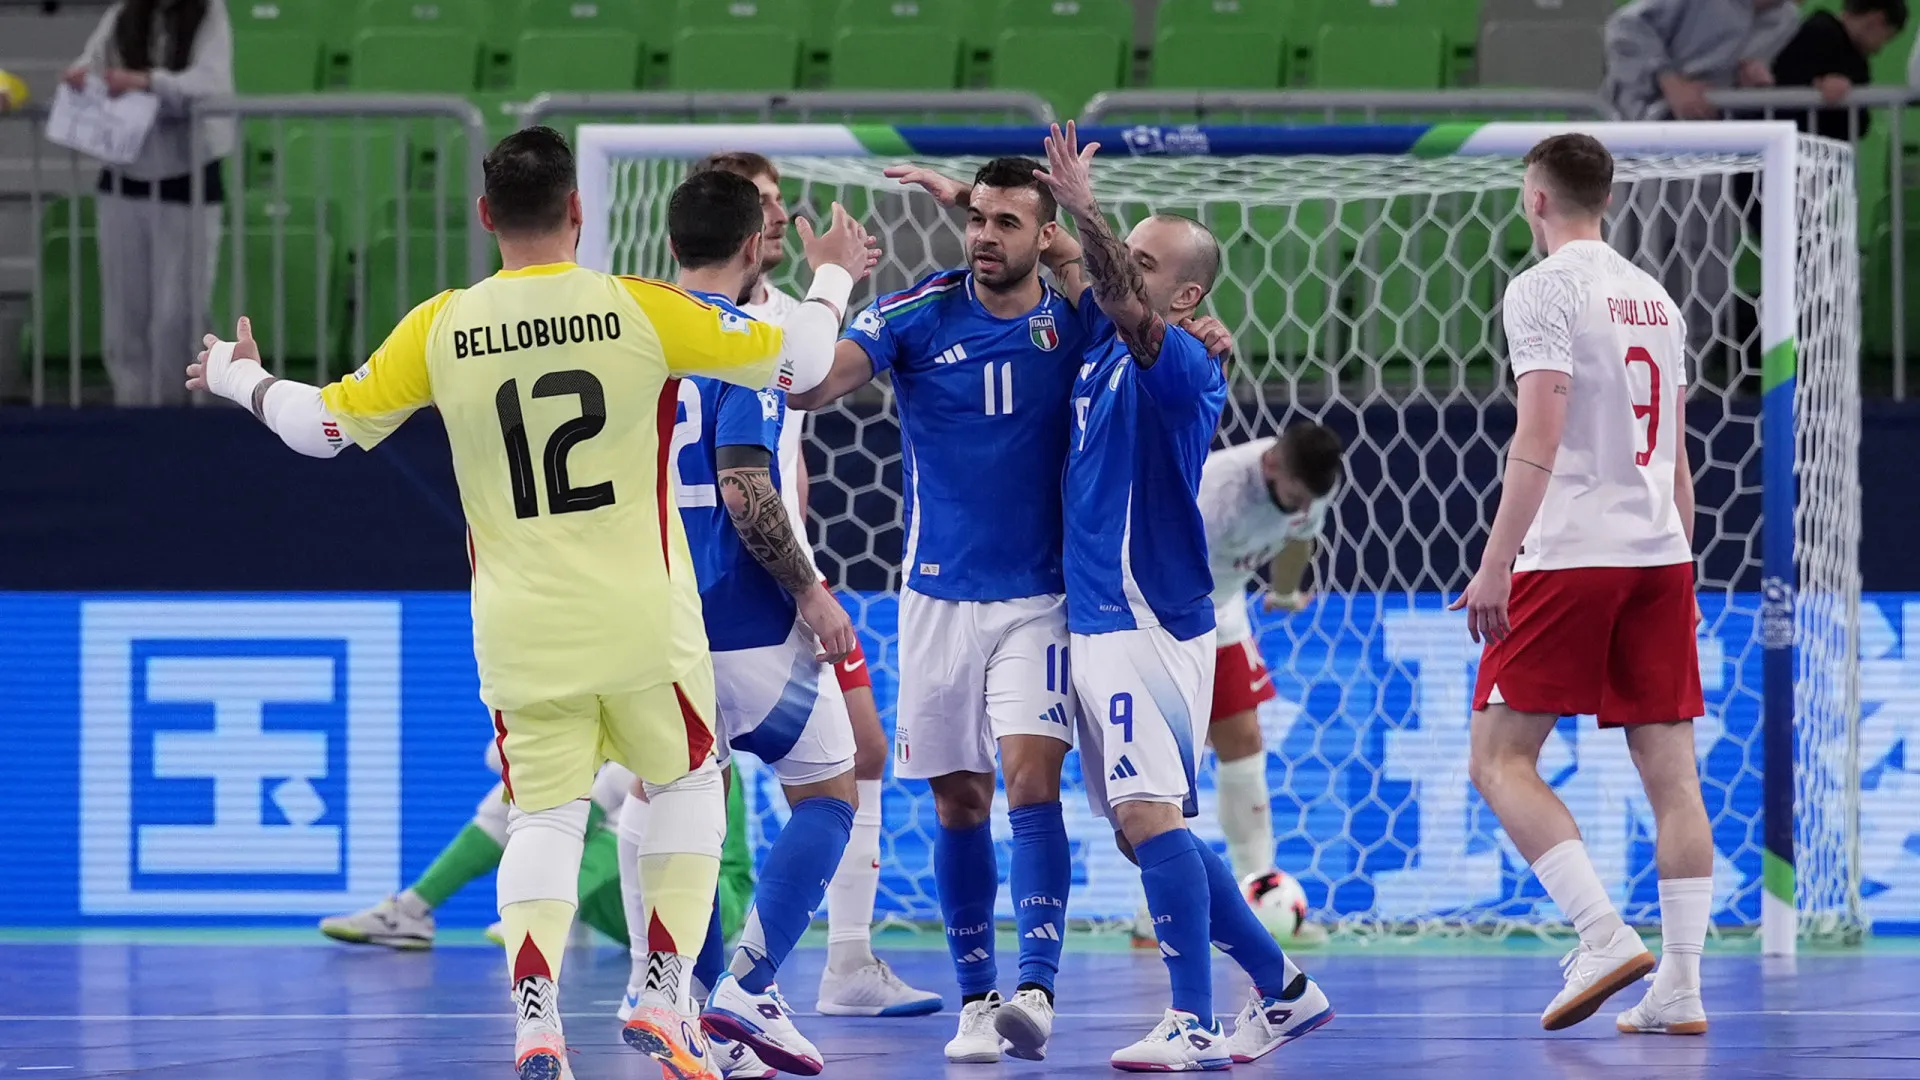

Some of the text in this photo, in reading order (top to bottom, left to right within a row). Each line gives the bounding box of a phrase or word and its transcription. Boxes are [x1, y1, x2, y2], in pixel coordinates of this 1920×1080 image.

[454, 311, 621, 360] BELLOBUONO
[1031, 318, 1054, 328] ITALIA
[1607, 297, 1669, 327] PAWLUS
[984, 361, 1013, 416] 11
[1624, 345, 1661, 468] 9
[495, 368, 616, 520] 12
[1046, 643, 1069, 697] 11
[1109, 692, 1133, 743] 9
[80, 601, 402, 916] 国
[1020, 895, 1063, 909] ITALIA
[947, 921, 989, 937] ITALIA
